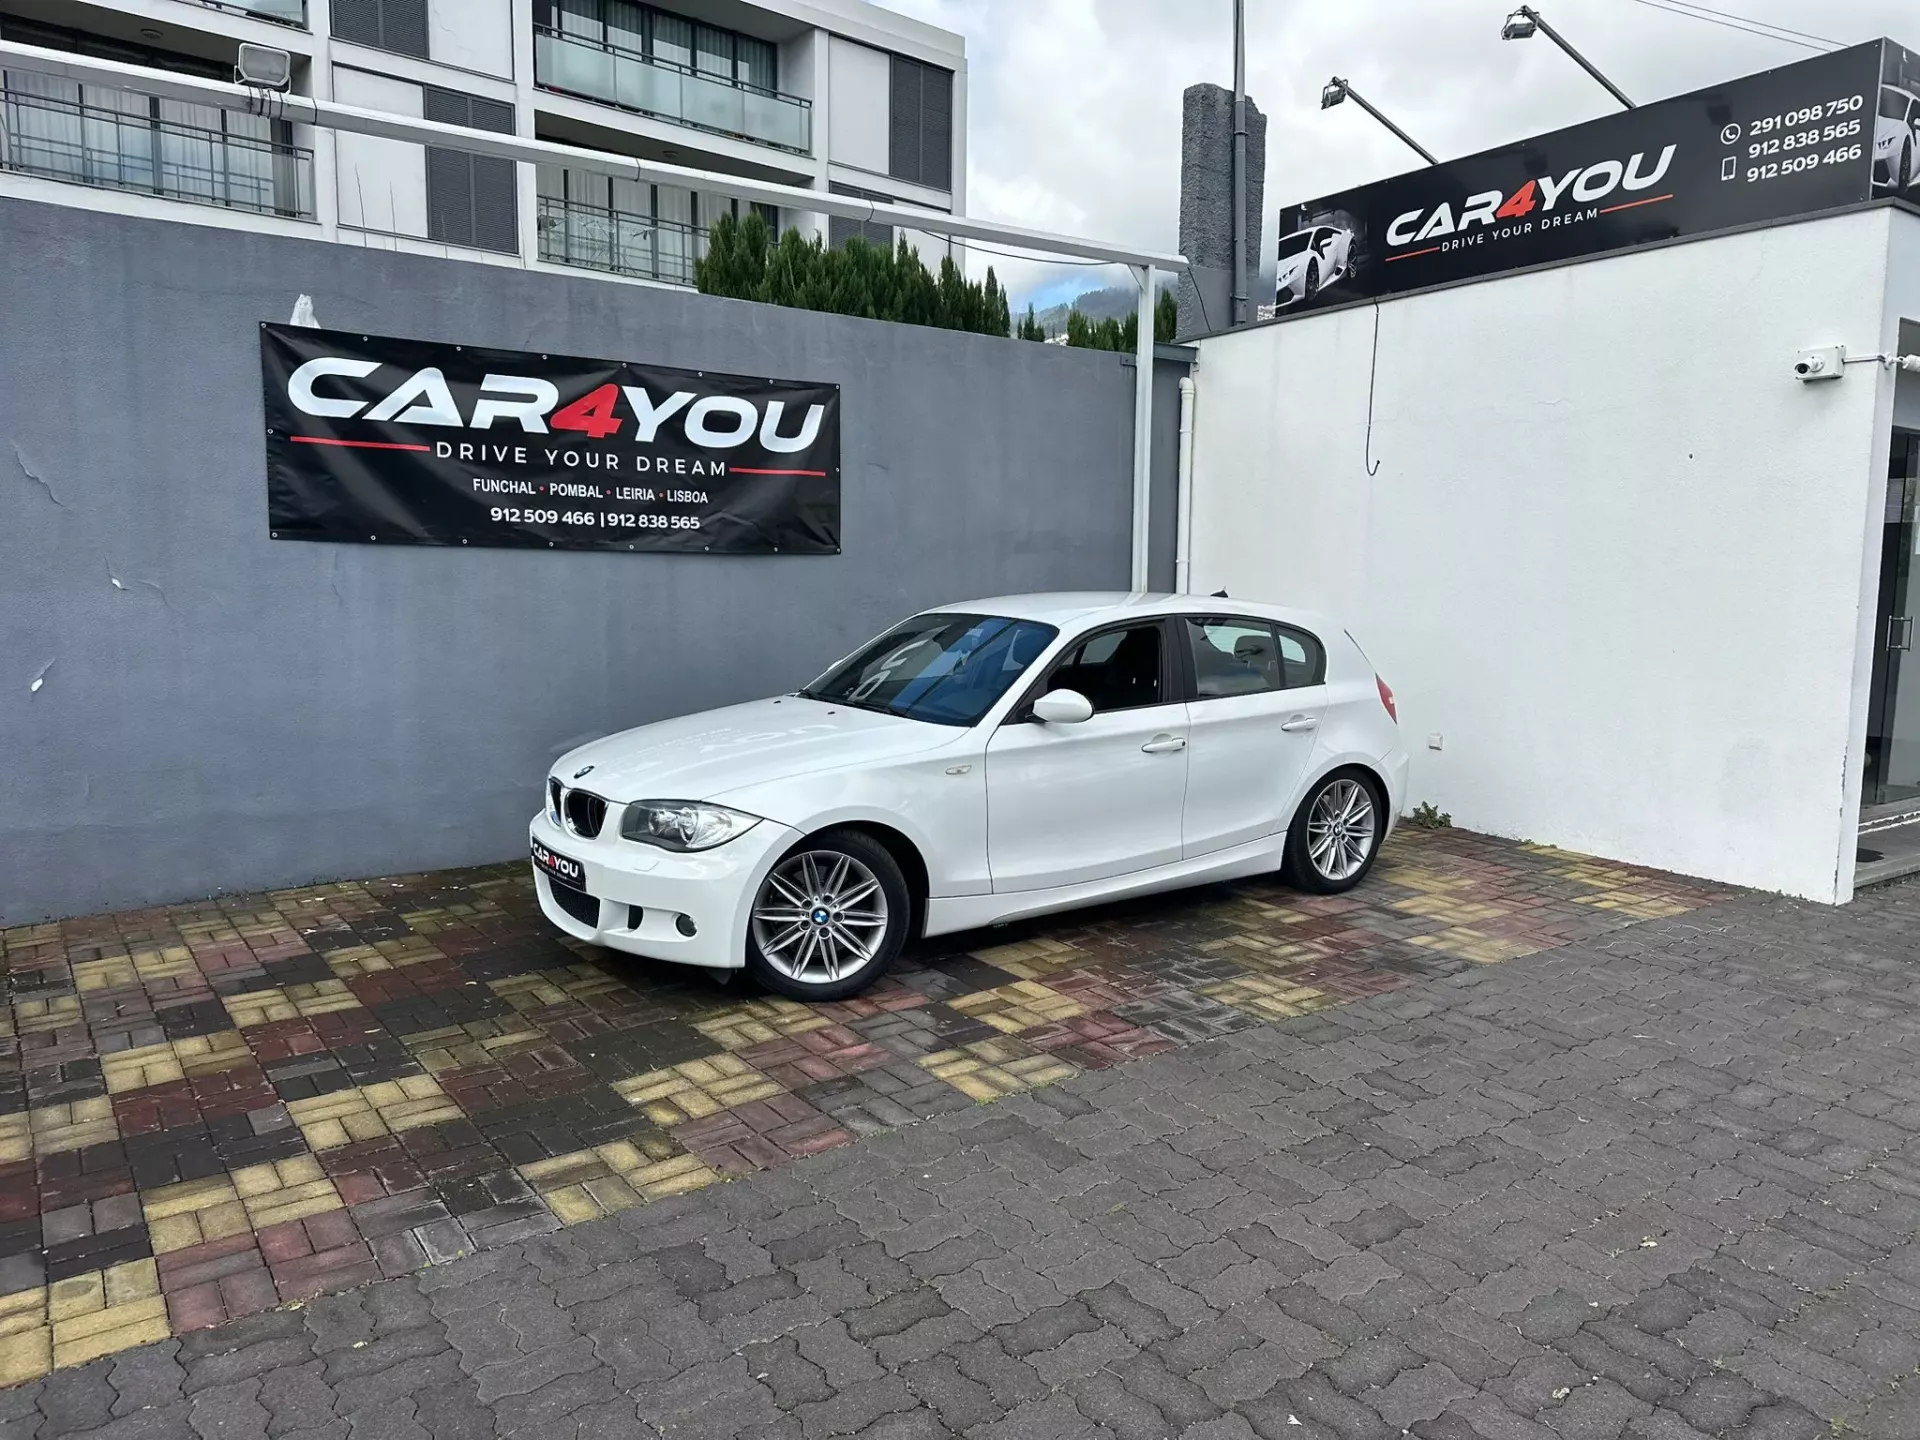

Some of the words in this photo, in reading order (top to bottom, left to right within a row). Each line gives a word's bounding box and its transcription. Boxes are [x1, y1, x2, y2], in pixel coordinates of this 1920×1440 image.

[1749, 114, 1782, 136] 291
[1784, 104, 1823, 127] 098
[1825, 94, 1864, 118] 750
[1748, 138, 1780, 158] 912
[1782, 129, 1820, 151] 838
[1822, 119, 1861, 142] 565
[1746, 163, 1778, 183] 912
[1780, 154, 1819, 175] 509
[1822, 143, 1862, 165] 466
[1385, 143, 1677, 247] CAR4YOU
[1441, 233, 1485, 252] DRIVE
[1491, 222, 1533, 241] YOUR
[1541, 207, 1599, 231] DREAM
[287, 356, 825, 454] CAR4YOU
[436, 441, 528, 464] DRIVE
[544, 449, 620, 470] YOUR
[636, 456, 726, 477] DREAM
[472, 478, 537, 495] FUNCHAL
[549, 483, 604, 499] POMBAL
[615, 487, 656, 501] LEIRIA
[666, 489, 709, 504] LISBOA
[490, 507, 521, 522] 912
[523, 508, 559, 525] 509
[561, 511, 595, 526] 466
[638, 514, 668, 529] 838
[670, 516, 700, 530] 565
